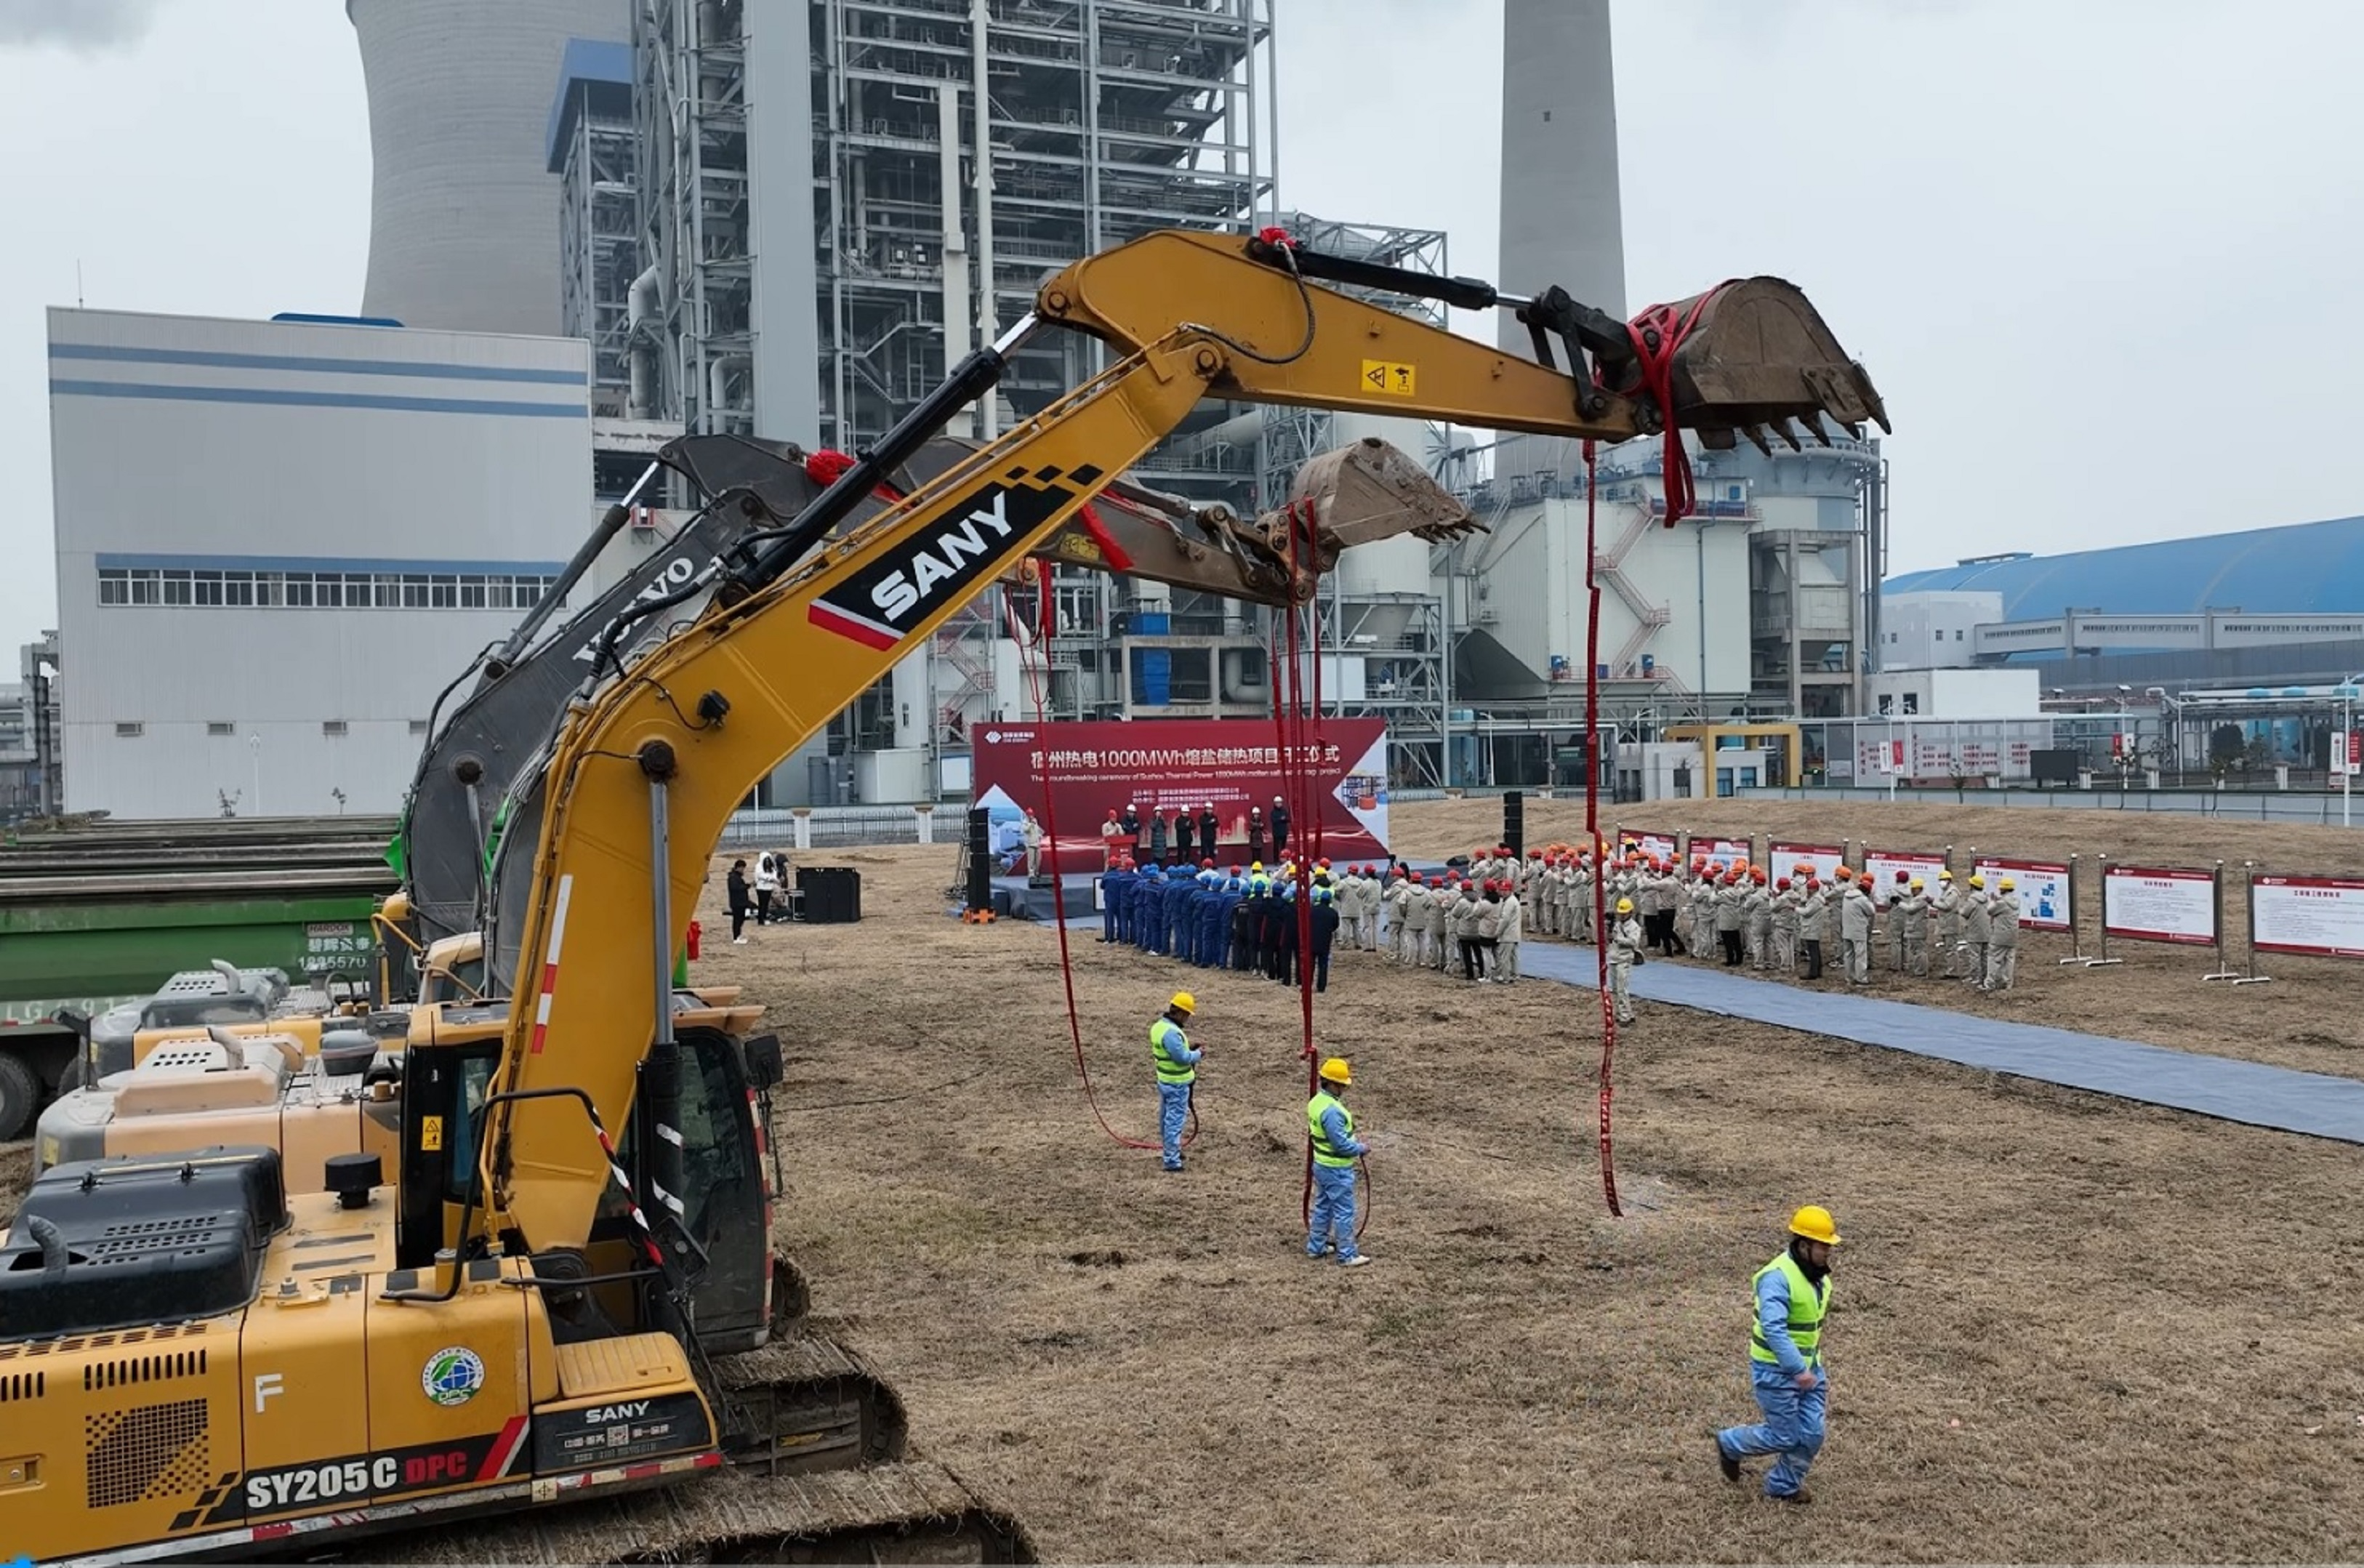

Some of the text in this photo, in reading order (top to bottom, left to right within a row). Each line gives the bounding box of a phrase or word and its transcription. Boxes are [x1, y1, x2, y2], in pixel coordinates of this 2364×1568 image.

[871, 490, 1012, 622] SANY
[255, 1373, 284, 1414] F
[586, 1401, 650, 1423] SANY
[405, 1452, 467, 1484] DPC
